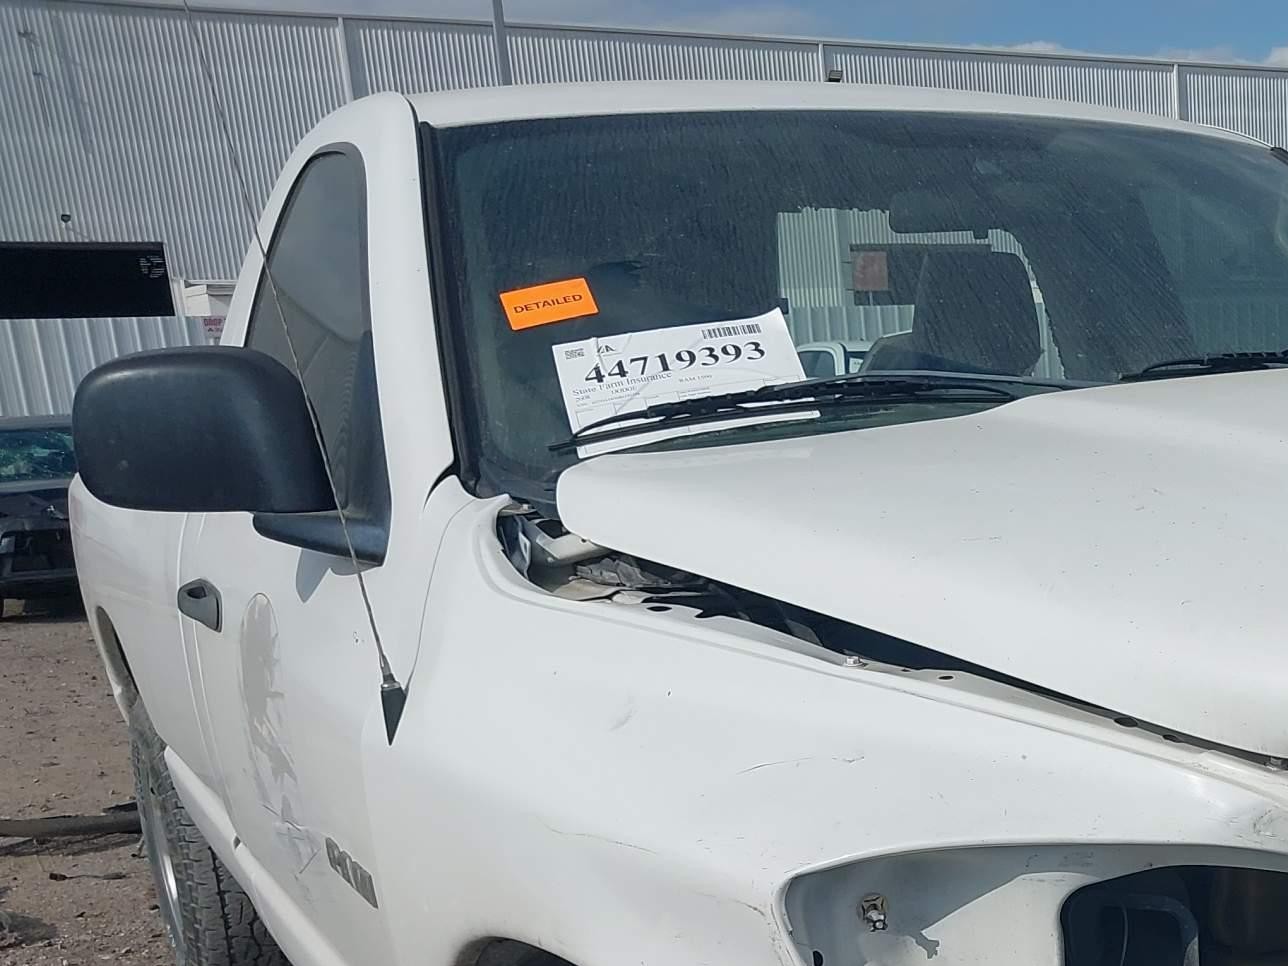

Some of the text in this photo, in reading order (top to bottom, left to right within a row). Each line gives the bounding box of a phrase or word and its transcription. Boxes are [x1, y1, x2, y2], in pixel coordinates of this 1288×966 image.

[513, 294, 583, 314] DETAILED
[584, 341, 766, 383] 44719393
[572, 372, 673, 396] State Farm Insurance
